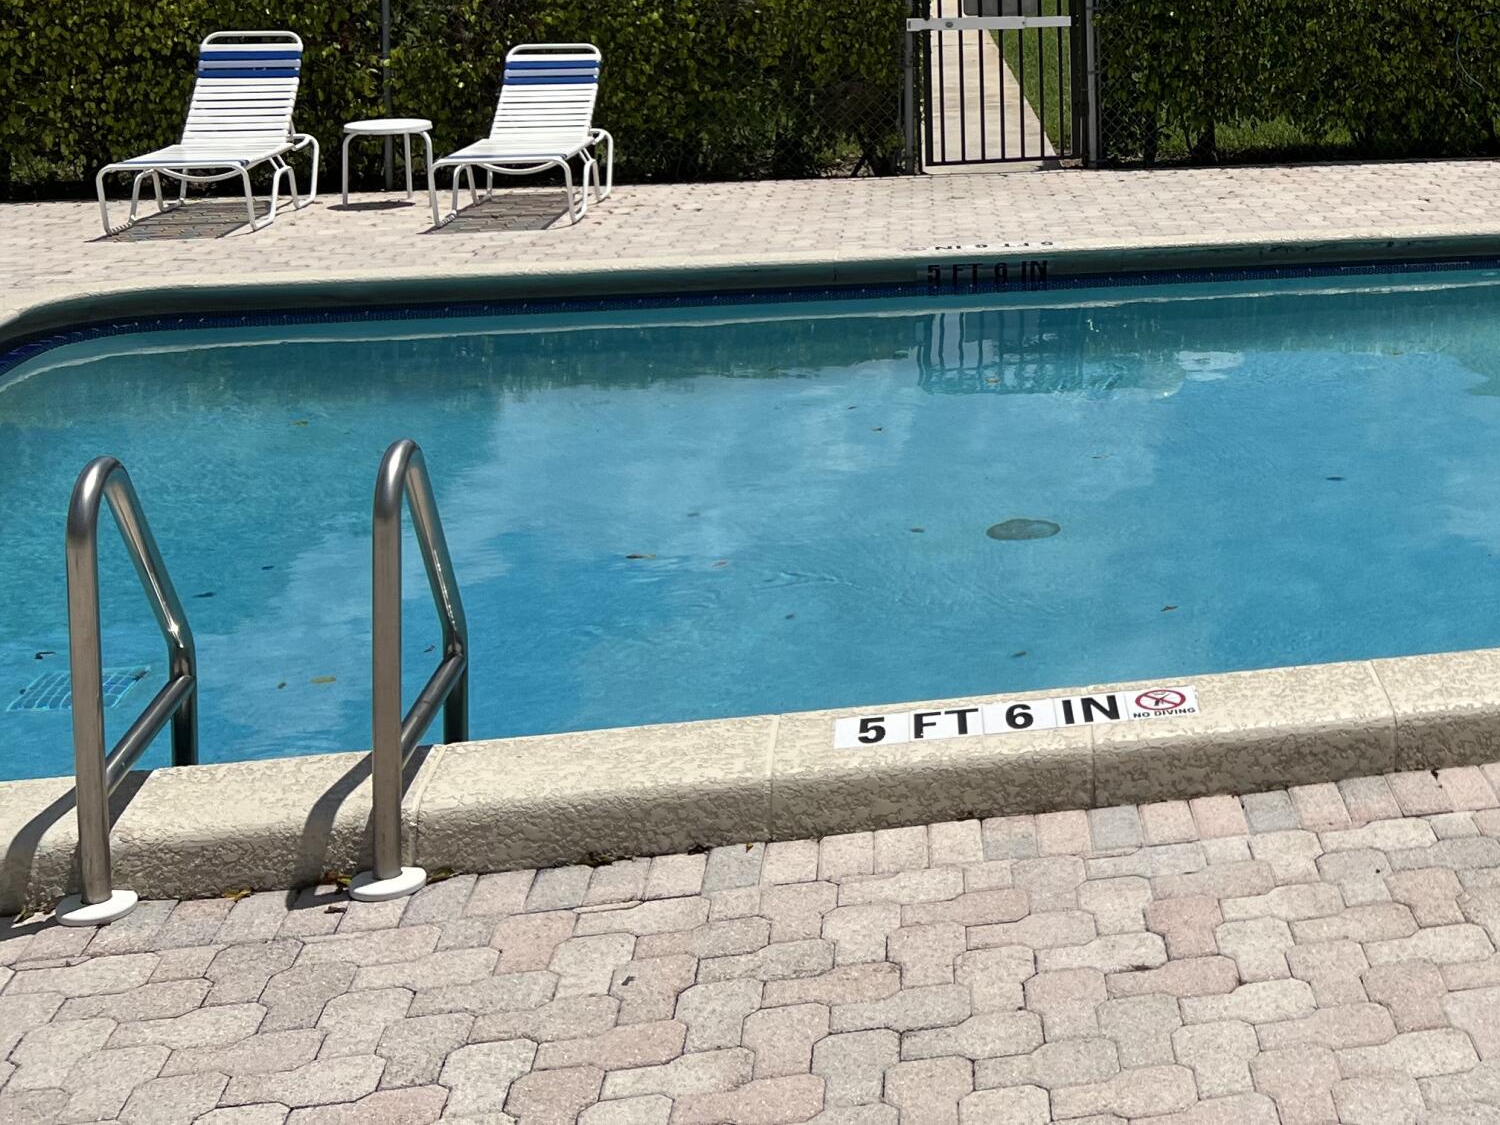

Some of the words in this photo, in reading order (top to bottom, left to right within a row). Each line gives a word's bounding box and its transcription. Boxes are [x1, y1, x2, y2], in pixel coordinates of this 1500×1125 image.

[927, 264, 941, 286] 5
[952, 262, 984, 285] FT
[1021, 260, 1048, 282] IN
[857, 716, 886, 744] 5
[913, 707, 979, 739] FT
[1005, 704, 1034, 729] 6
[1061, 695, 1120, 725] IN
[1154, 707, 1196, 717] DIVING
